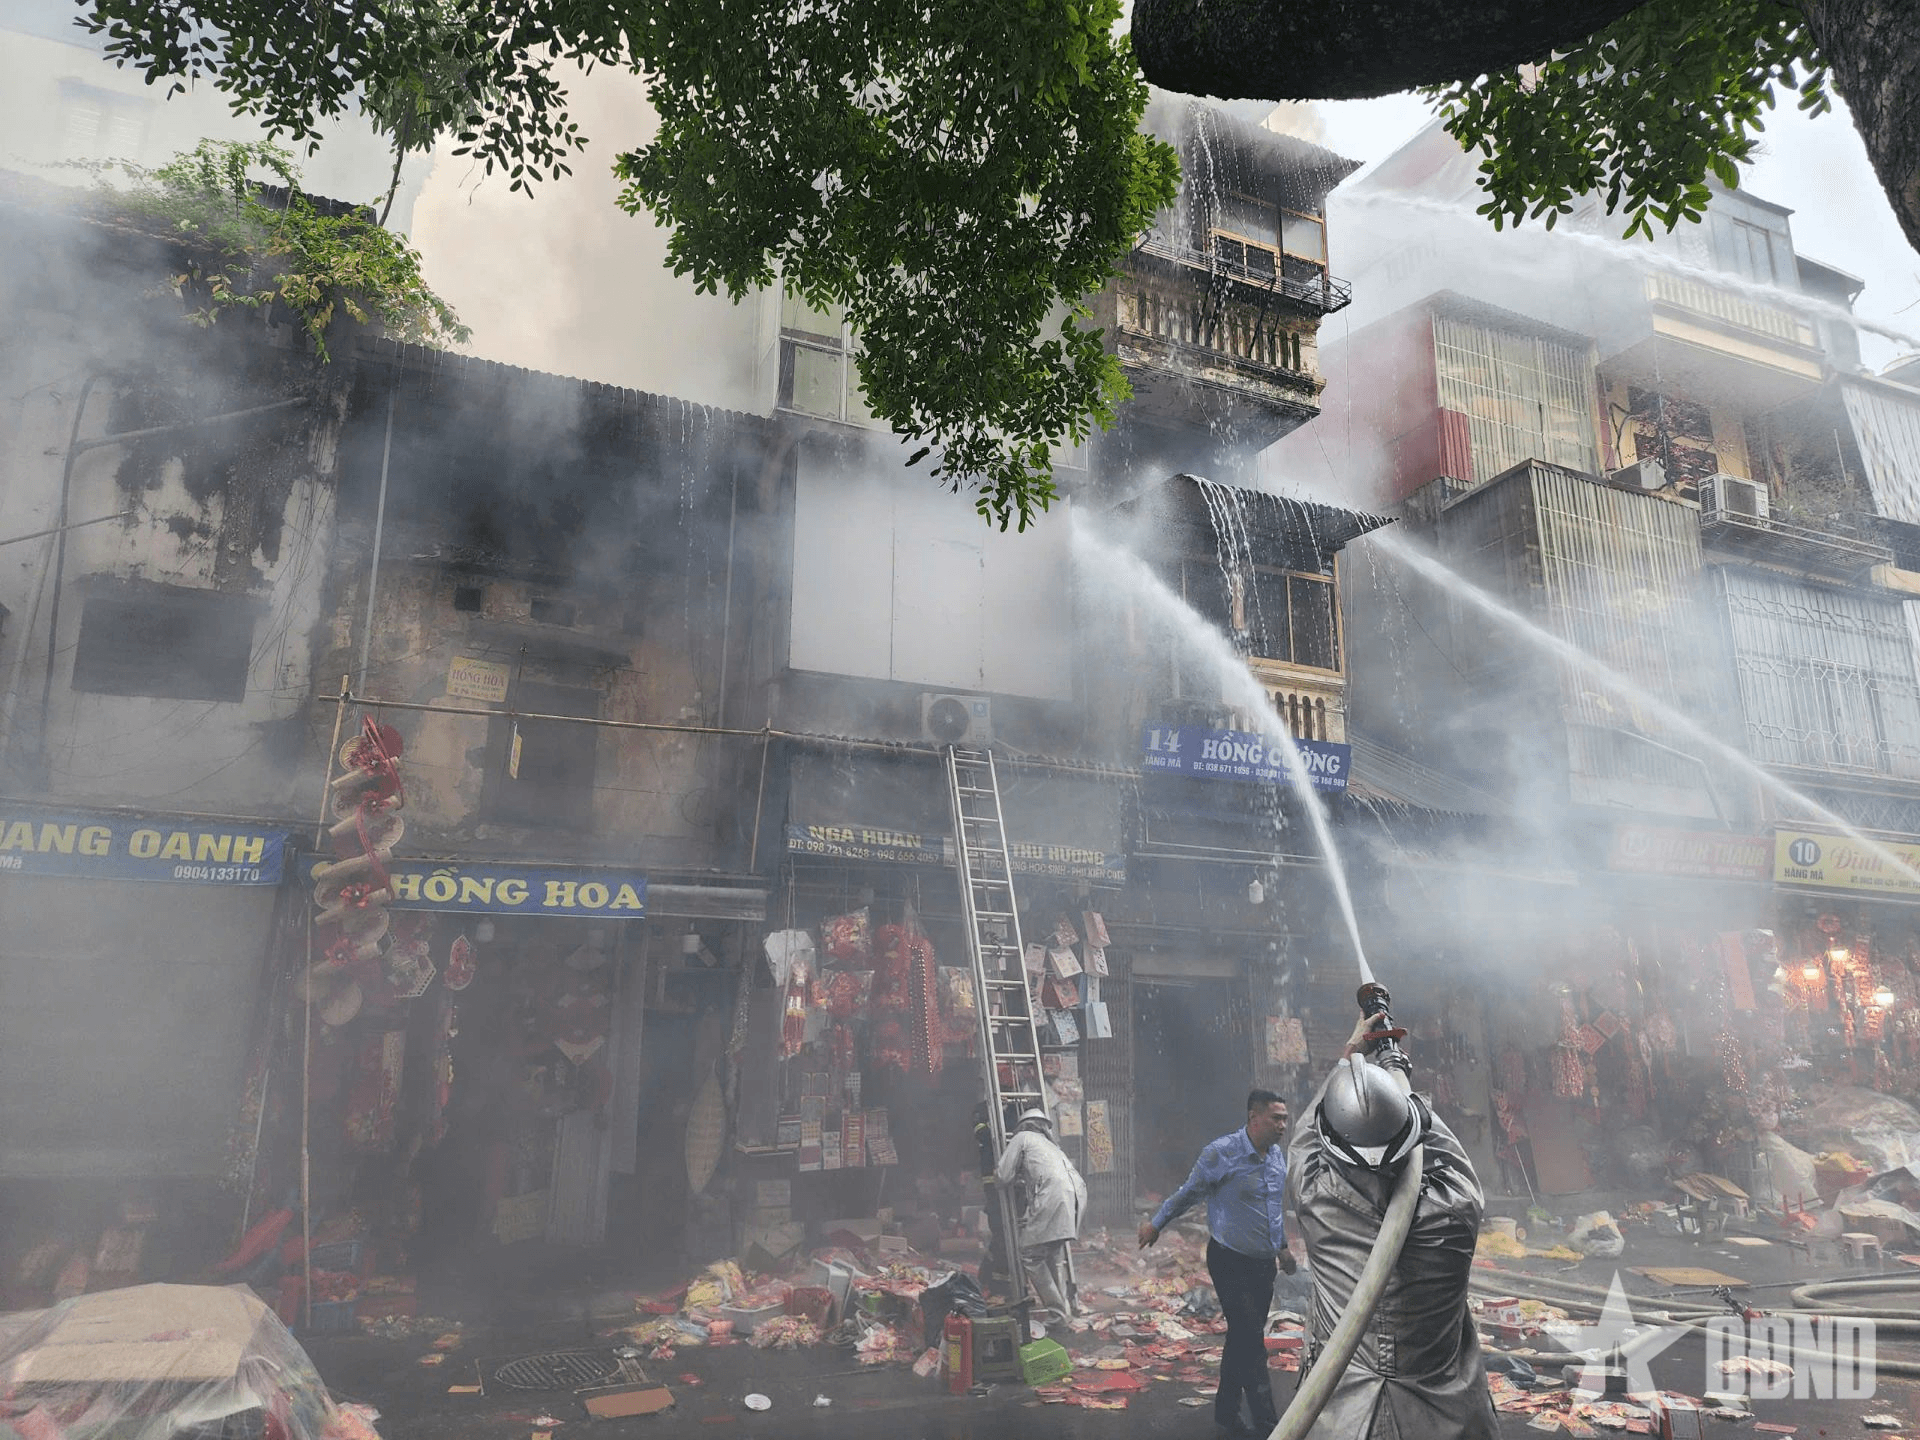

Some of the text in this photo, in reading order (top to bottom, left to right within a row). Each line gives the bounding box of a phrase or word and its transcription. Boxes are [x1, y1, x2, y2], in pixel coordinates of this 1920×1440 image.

[1146, 729, 1181, 752] 14
[1202, 732, 1262, 764] HỒNG
[0, 821, 265, 863] ANG OANH
[808, 825, 855, 843] NGA
[1796, 842, 1815, 863] 10
[174, 865, 260, 881] 0904133170
[390, 866, 643, 909] HỒNG HOA
